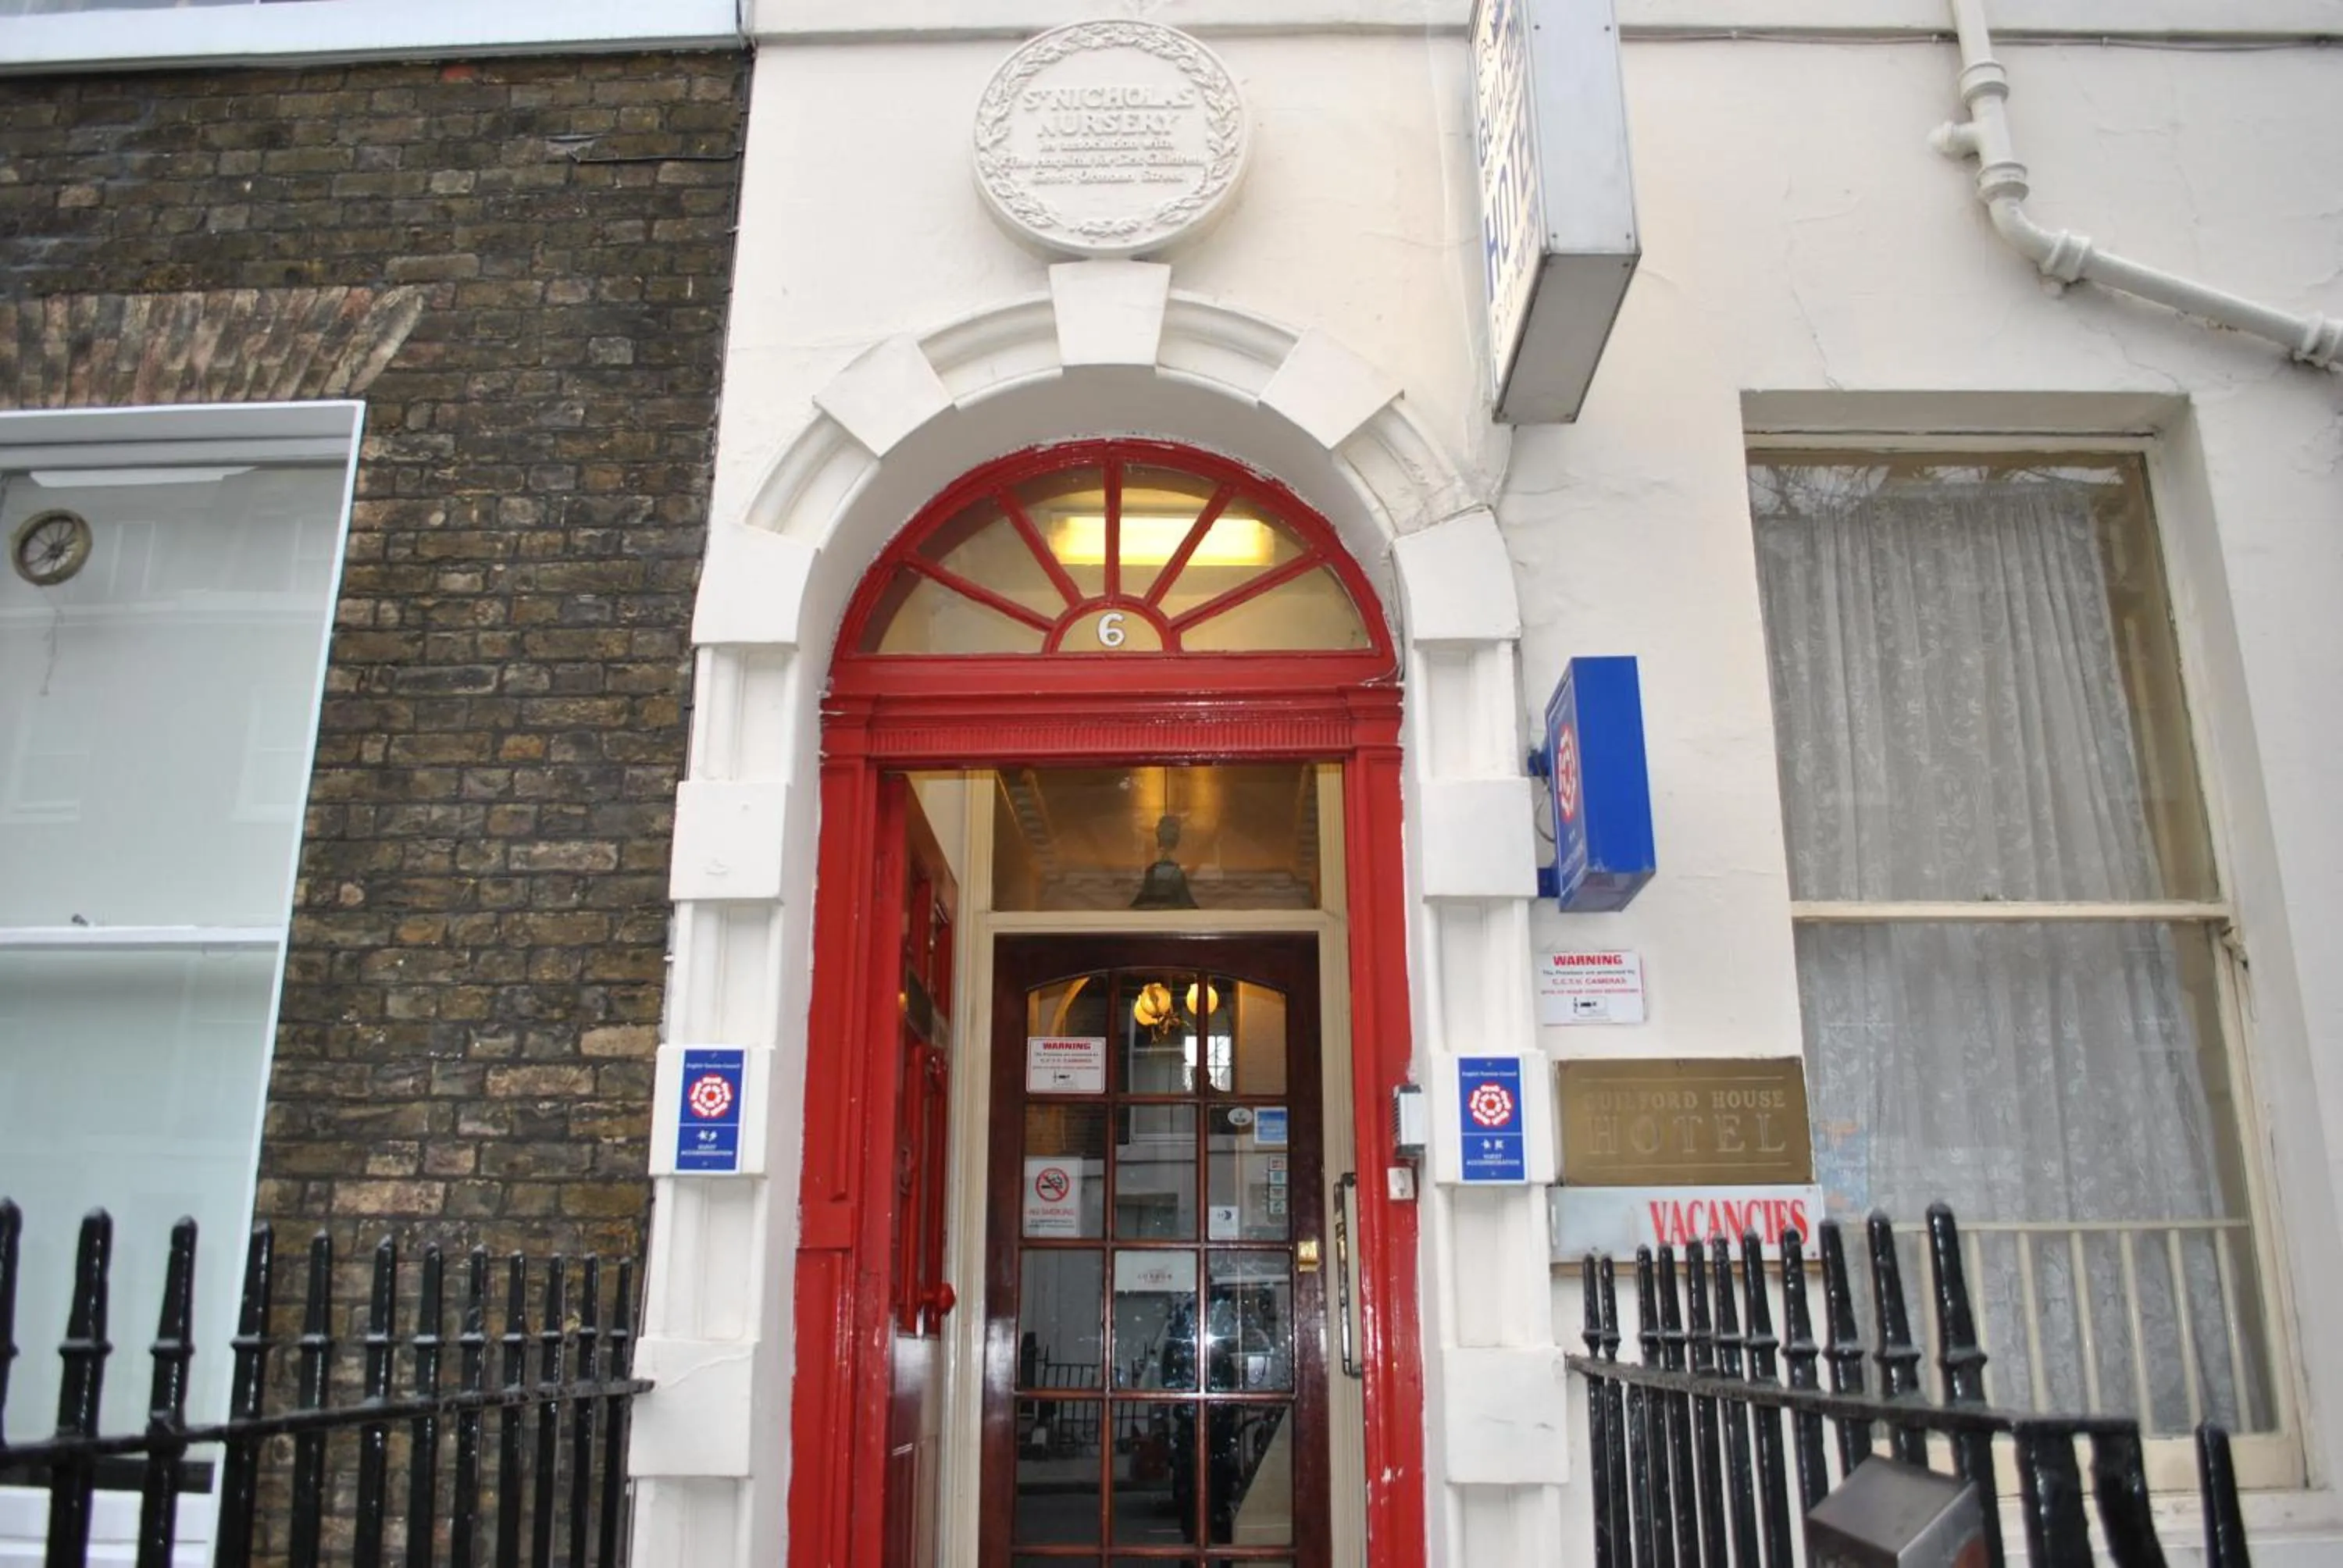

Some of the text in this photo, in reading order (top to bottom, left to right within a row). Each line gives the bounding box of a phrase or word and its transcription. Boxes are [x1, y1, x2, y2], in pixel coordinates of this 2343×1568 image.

[1098, 612, 1125, 647] 6
[1553, 954, 1623, 966] WARNING
[1043, 1042, 1091, 1050] WARNING
[1712, 1089, 1786, 1109] HOUSE
[1586, 1112, 1787, 1155] HOTEL
[1649, 1199, 1809, 1247] VACANCIES
